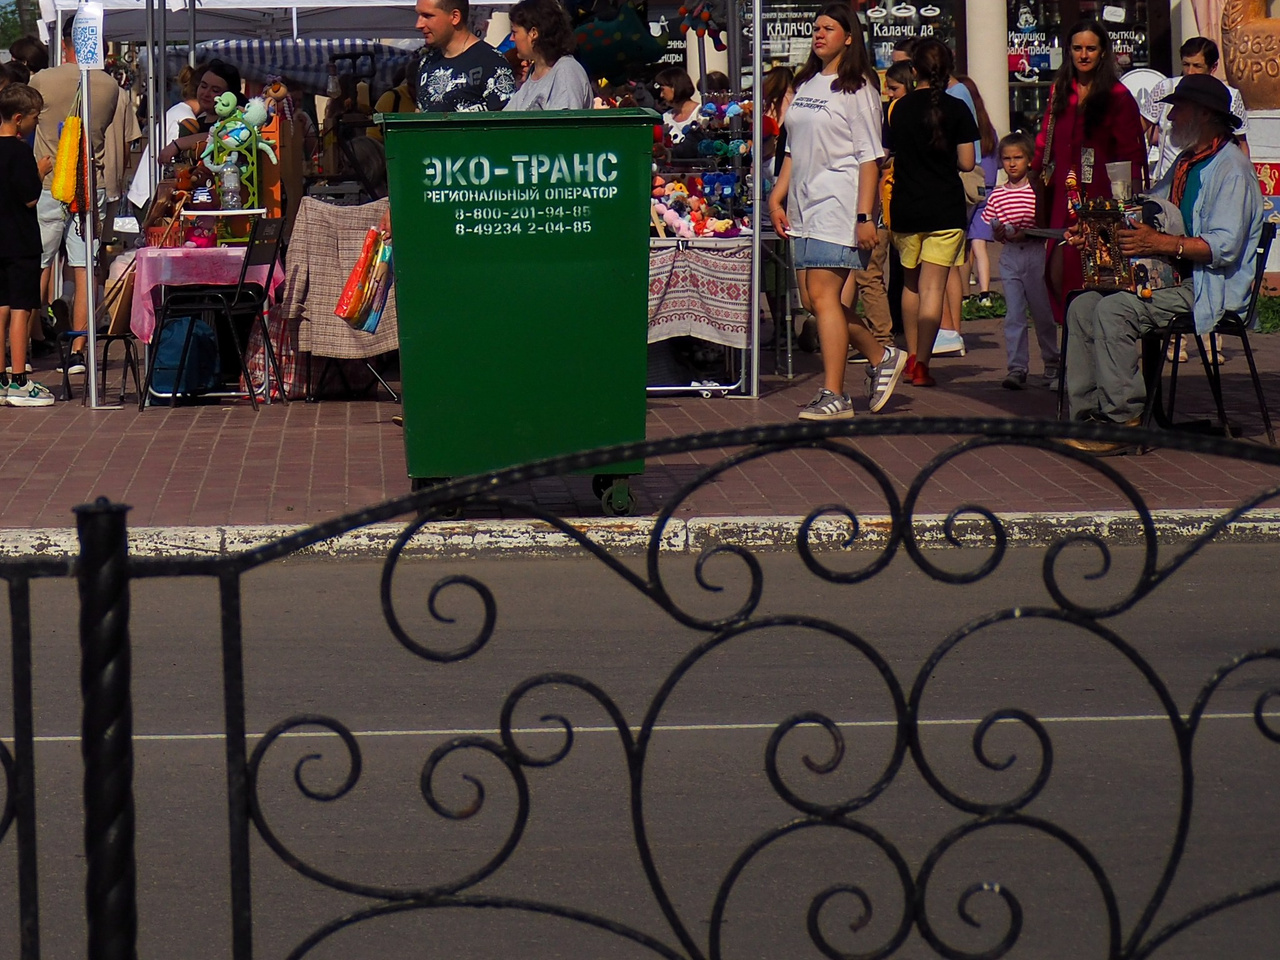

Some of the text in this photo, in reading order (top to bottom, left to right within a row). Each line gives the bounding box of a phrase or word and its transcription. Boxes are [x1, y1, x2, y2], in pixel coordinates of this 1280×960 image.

[766, 22, 815, 36] КАЛАЧО
[920, 24, 934, 37] да
[1008, 30, 1046, 43] Игрушки
[422, 152, 618, 186] ЭКО-ТРАНС
[424, 187, 618, 203] РЕГИОНАЛЬНЫЙ ОПЕРАТОР
[455, 206, 591, 220] 8-800-201-94-85
[455, 221, 592, 235] 8-49234 2-04-85
